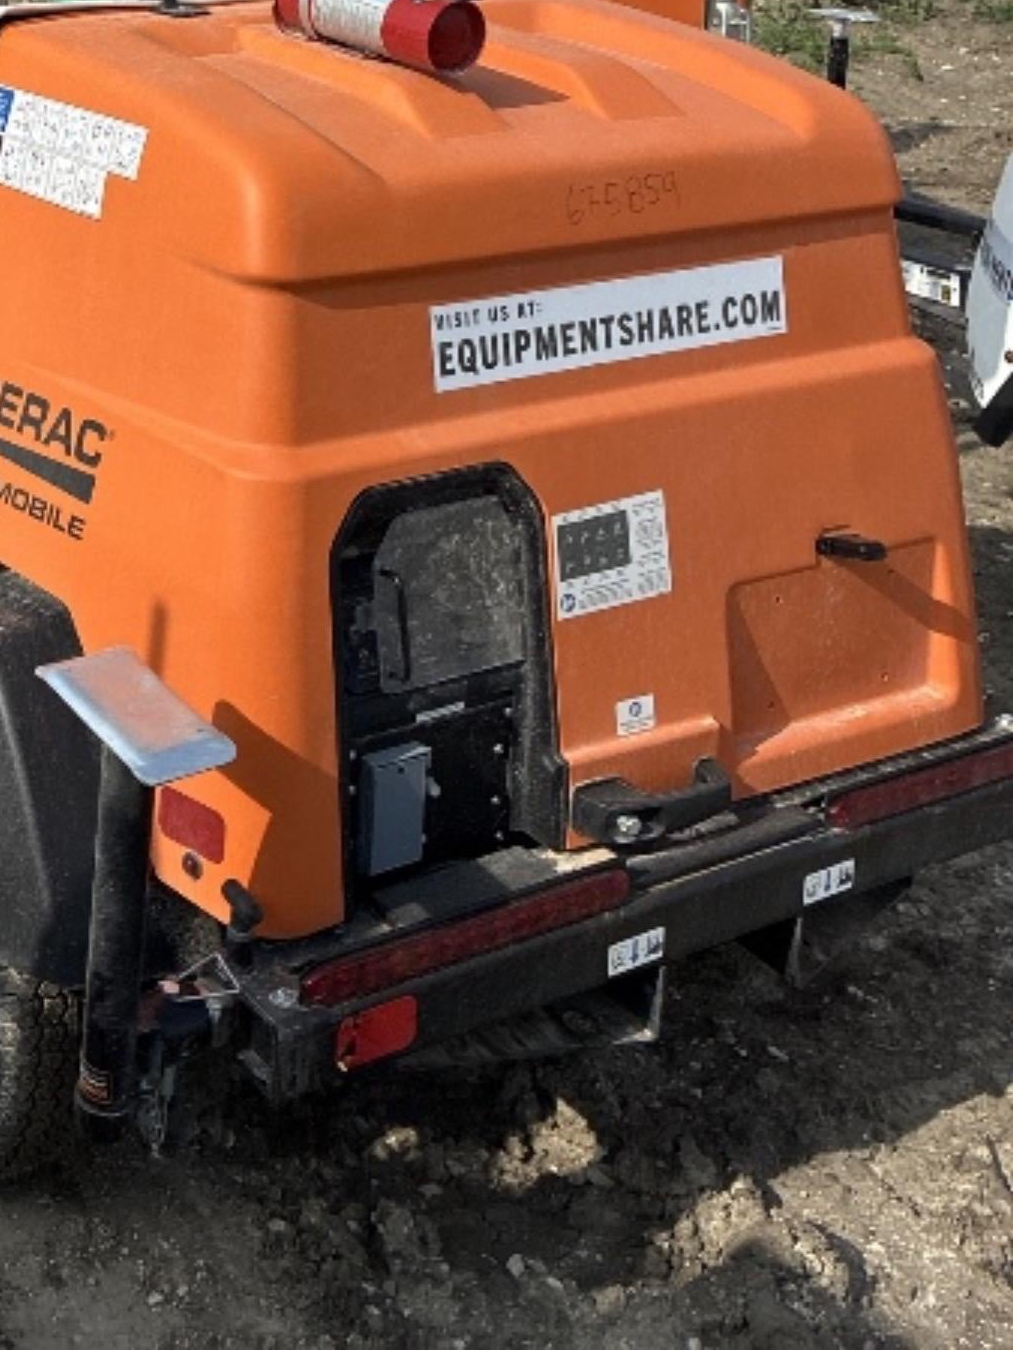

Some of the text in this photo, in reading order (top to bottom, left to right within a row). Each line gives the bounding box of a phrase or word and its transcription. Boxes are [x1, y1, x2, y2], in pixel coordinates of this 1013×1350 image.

[434, 300, 544, 330] VISIT US AT:
[439, 290, 781, 377] EQUIPMENTSHARE.COM
